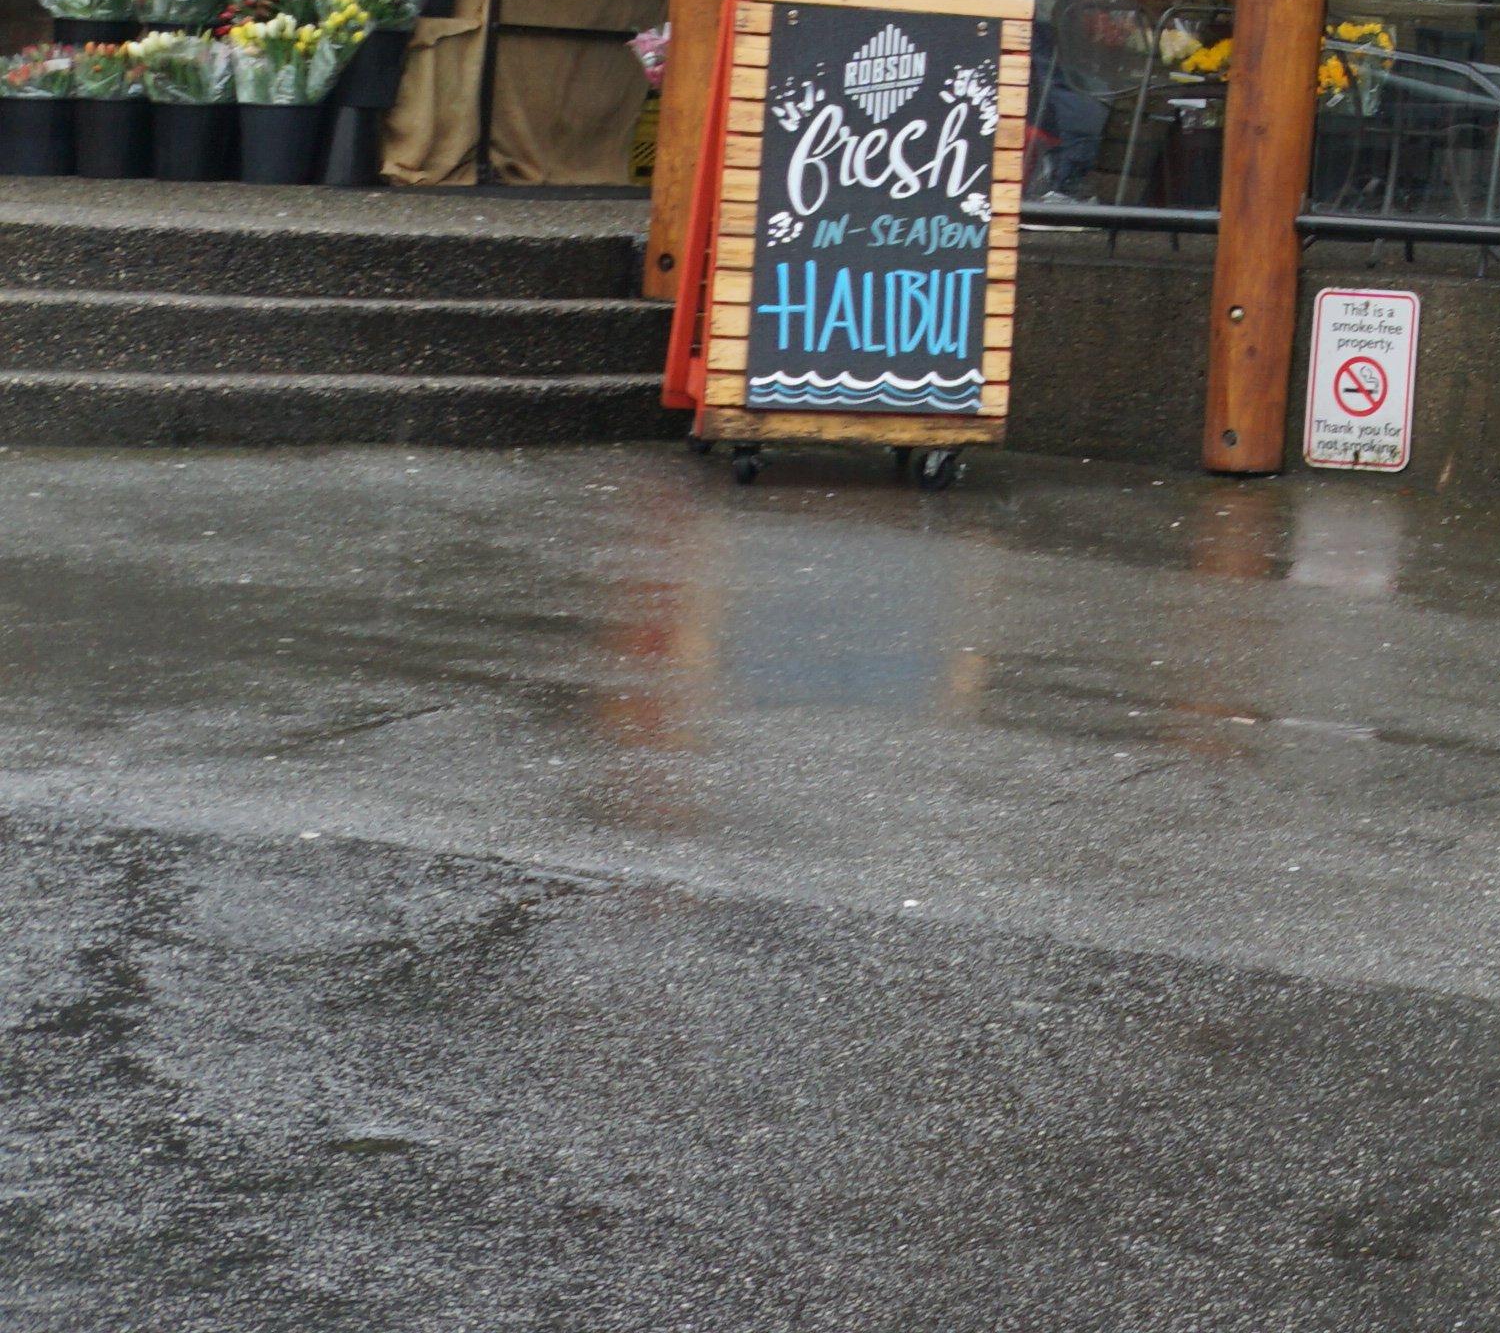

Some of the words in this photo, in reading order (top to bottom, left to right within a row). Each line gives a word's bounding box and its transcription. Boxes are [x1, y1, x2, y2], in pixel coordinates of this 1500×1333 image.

[843, 51, 928, 88] ROBSON
[787, 102, 988, 216] fresh
[812, 212, 989, 256] IN-SEASON
[757, 259, 986, 360] HALIBUT
[1342, 302, 1369, 318] This
[1372, 303, 1385, 318] is
[1387, 307, 1396, 318] a
[1331, 319, 1403, 335] smoke-free
[1336, 336, 1395, 353] property.
[1314, 419, 1354, 434] Thank
[1357, 423, 1382, 439] you
[1383, 421, 1403, 437] for
[1316, 439, 1338, 451] not
[1341, 439, 1400, 458] smoking.
